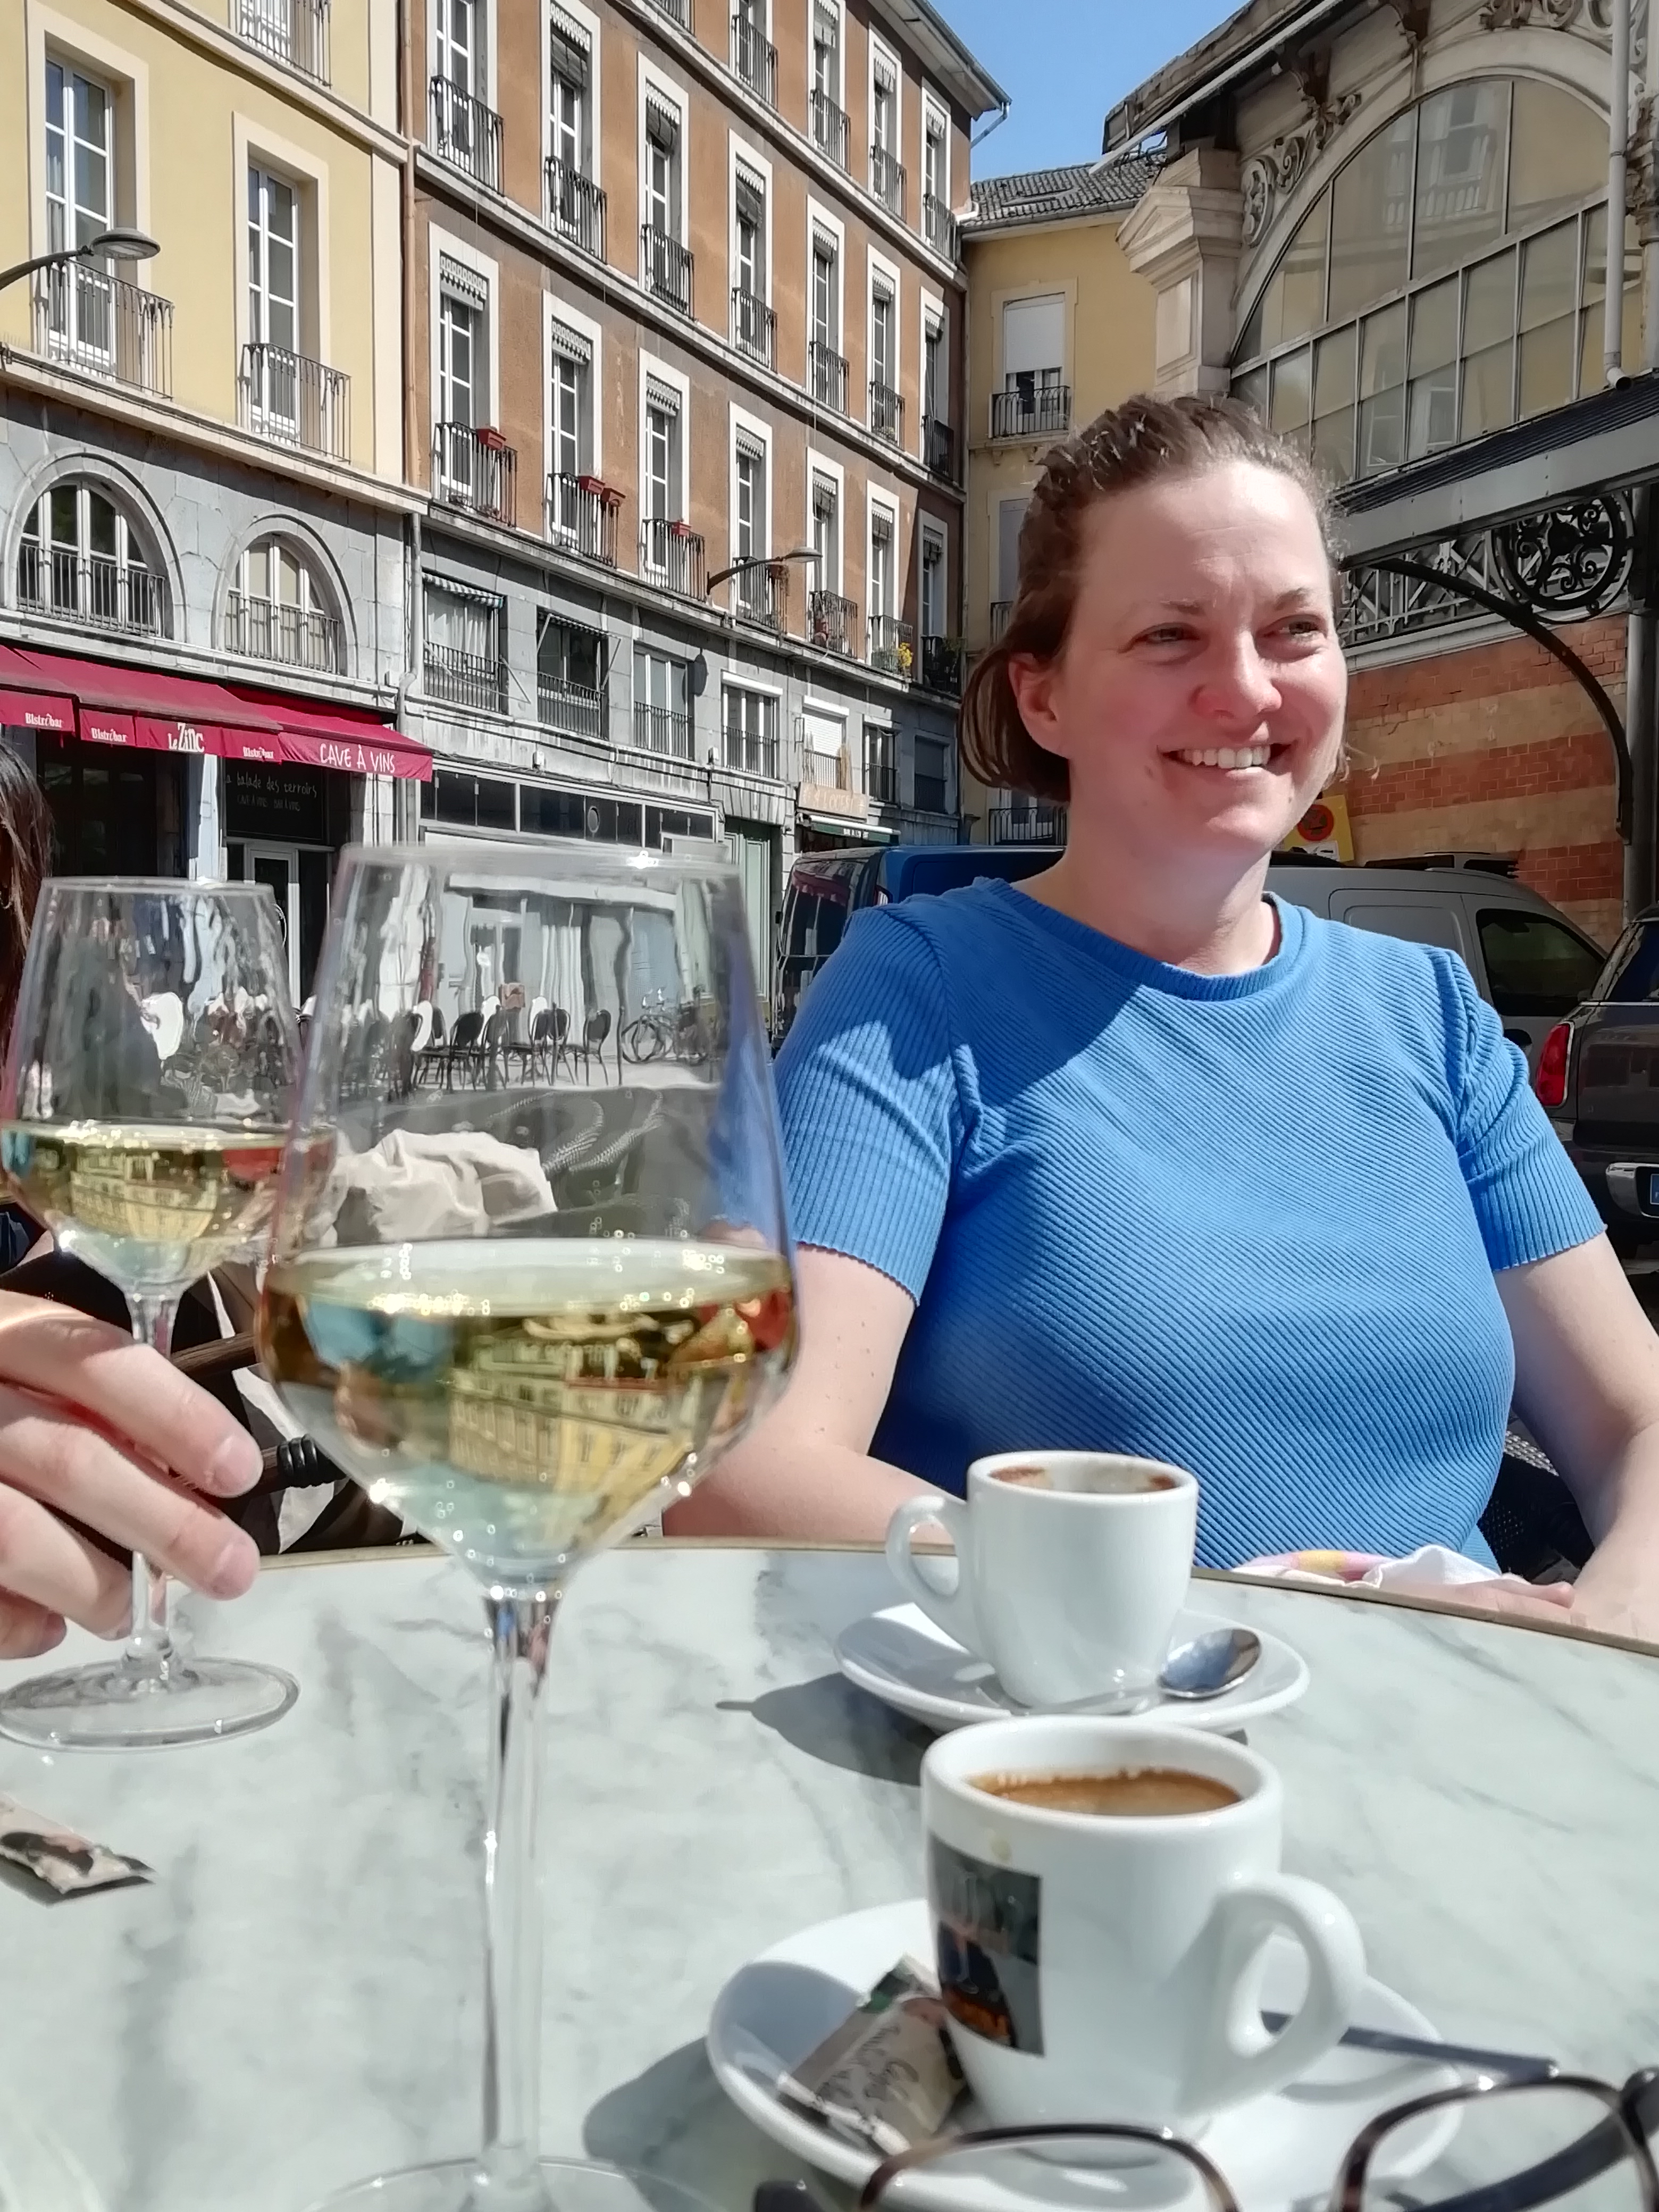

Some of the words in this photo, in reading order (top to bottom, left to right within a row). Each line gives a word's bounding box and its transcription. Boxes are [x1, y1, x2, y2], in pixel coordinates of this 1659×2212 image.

[167, 733, 178, 750] Le
[177, 722, 205, 752] Zinc
[320, 743, 352, 767] CAVE
[357, 744, 366, 770] À
[370, 751, 396, 773] VINS
[237, 771, 262, 789] balade
[266, 775, 280, 793] des
[284, 782, 317, 798] terroirs
